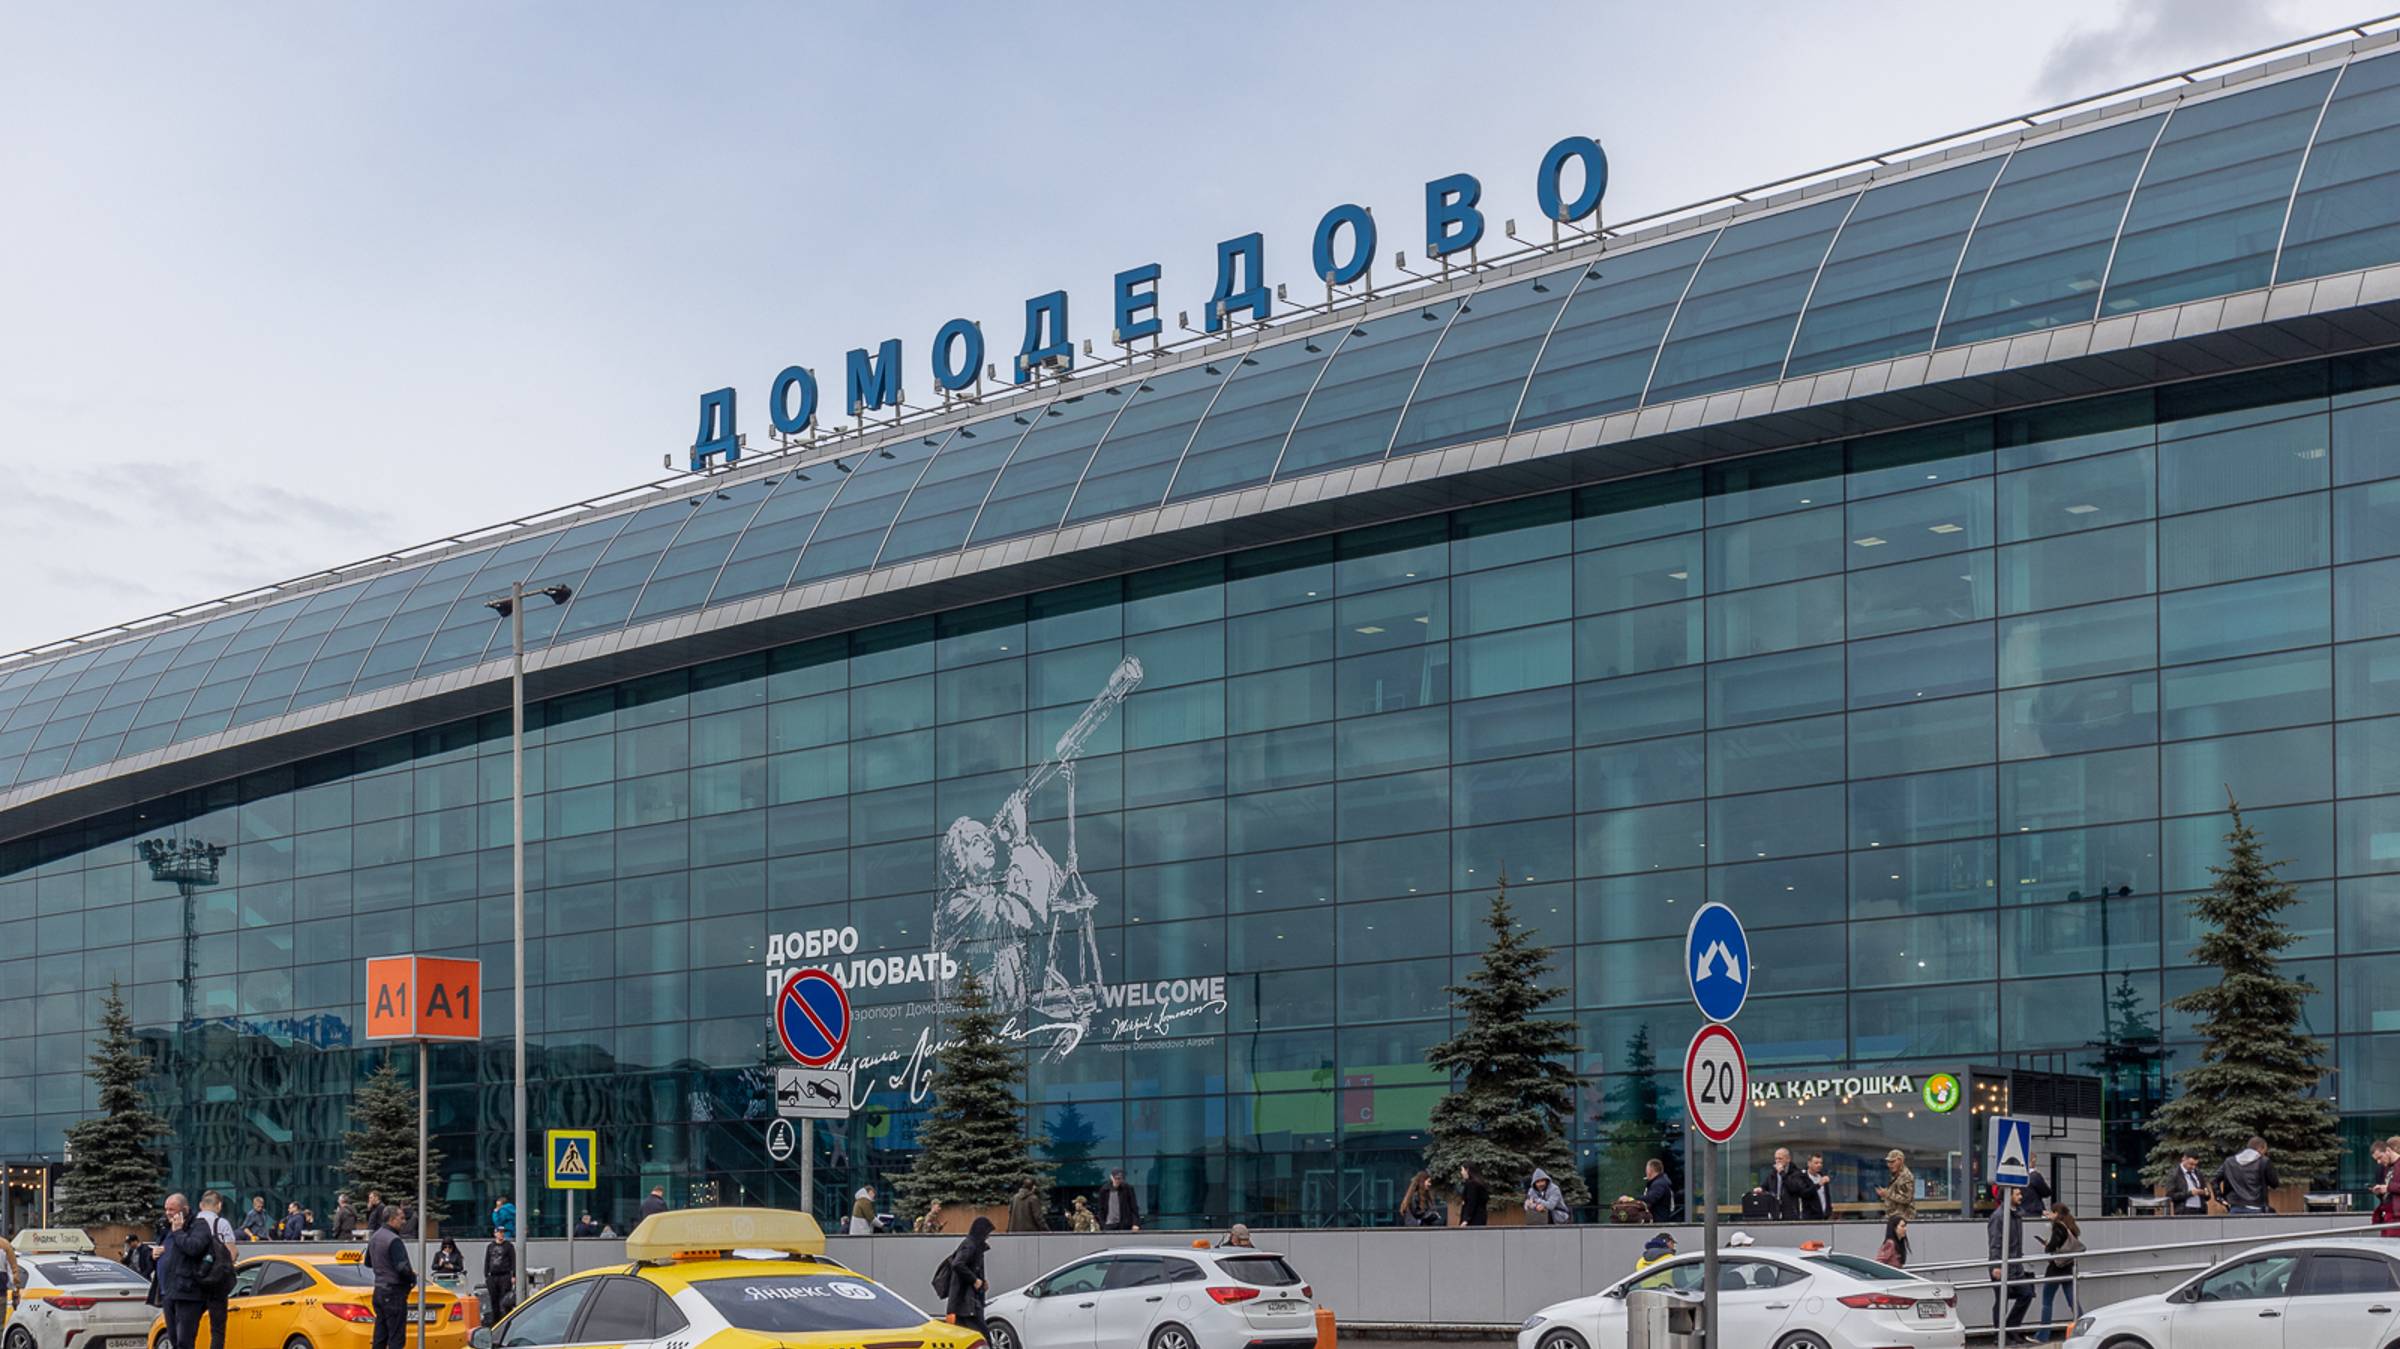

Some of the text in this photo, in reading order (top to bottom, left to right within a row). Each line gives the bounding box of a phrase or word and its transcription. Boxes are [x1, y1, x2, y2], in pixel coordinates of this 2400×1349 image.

[691, 136, 1608, 471] ДОМОДЕДОВО
[766, 926, 859, 967] ДОБРО
[766, 952, 957, 996] ПАЛОВАТЬ
[1103, 976, 1225, 1009] WELCOME
[1101, 1036, 1215, 1053] Moscow Domodedovo Airport
[1701, 1060, 1734, 1105] 20
[1787, 1075, 1913, 1098] КАРТОШКА
[744, 1286, 831, 1300] Яндекс
